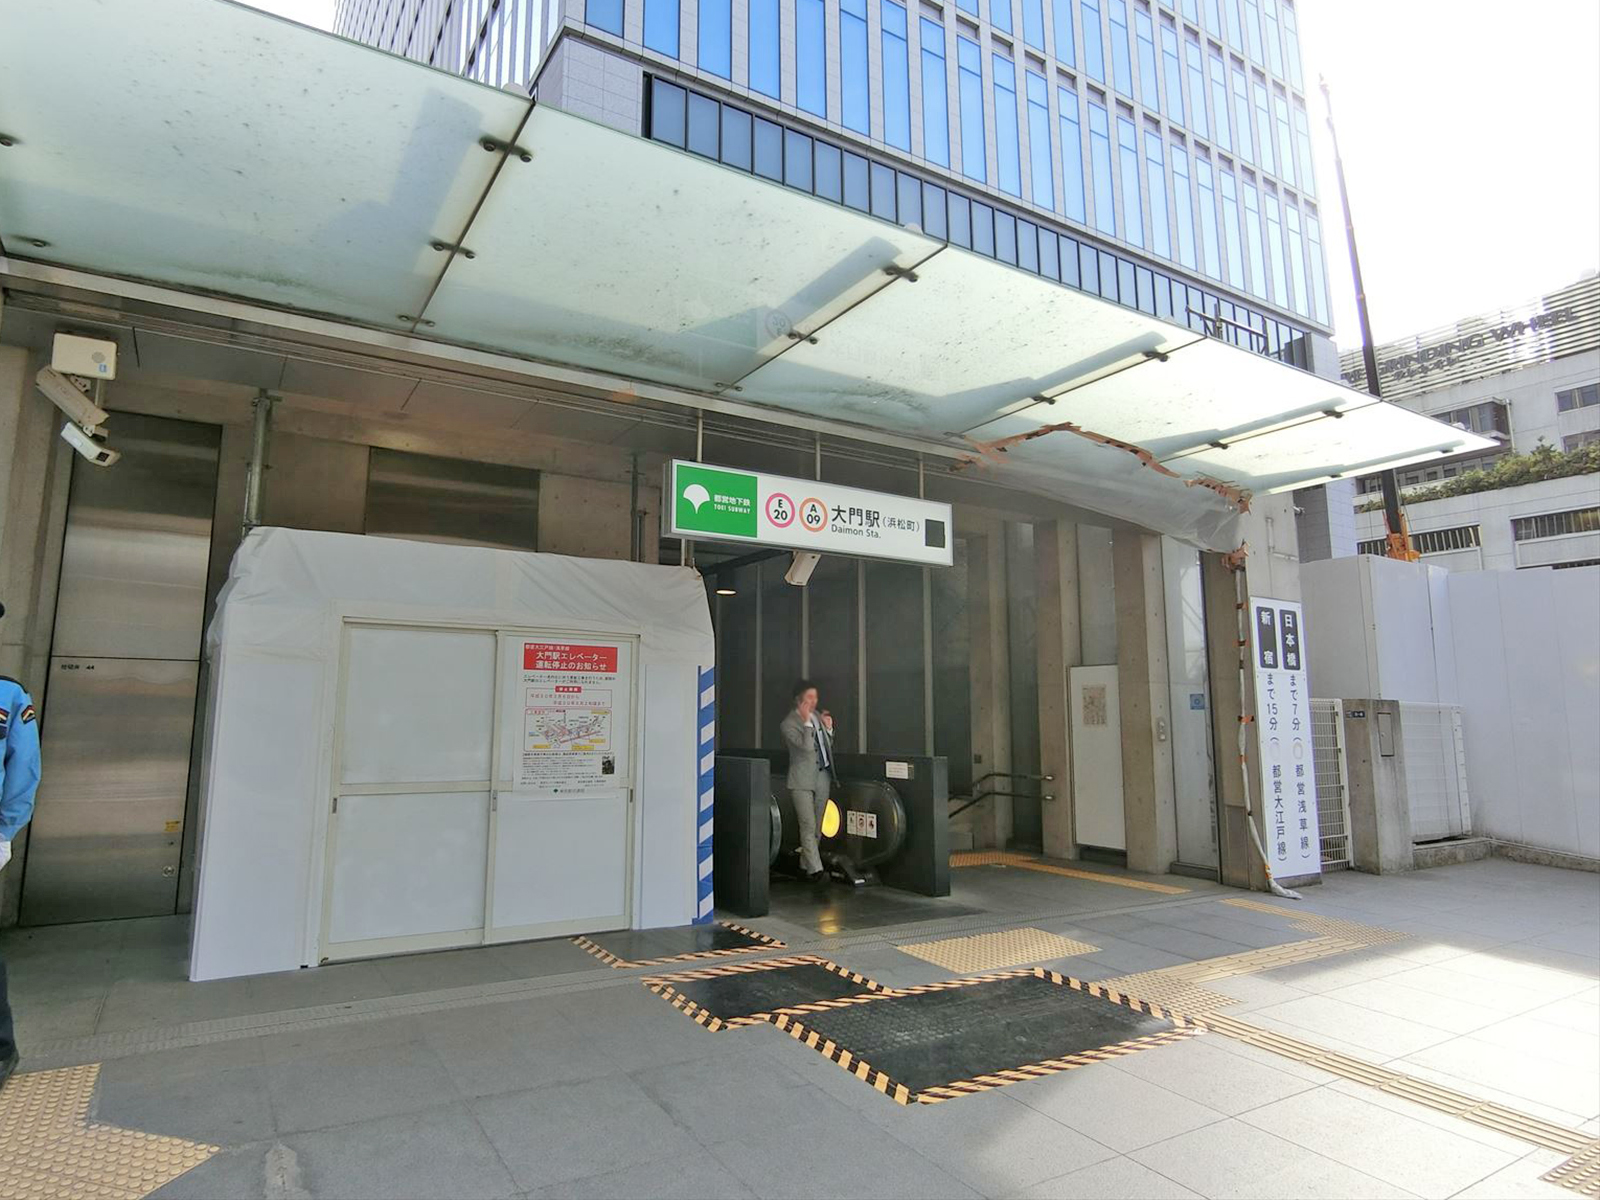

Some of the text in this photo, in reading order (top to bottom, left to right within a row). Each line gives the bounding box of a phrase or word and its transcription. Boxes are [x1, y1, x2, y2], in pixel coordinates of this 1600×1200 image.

[1377, 334, 1485, 375] GRINDING
[1490, 306, 1580, 342] WHEEL
[713, 494, 751, 507] 都営地下鉄
[777, 498, 783, 509] E
[714, 503, 751, 514] TOEI SUBWAY
[810, 503, 818, 513] A
[773, 509, 788, 521] 20
[806, 513, 821, 525] 09
[831, 504, 920, 533] 大門駅 （浜松町）
[831, 524, 881, 539] Daimon Sta.
[1260, 610, 1274, 666] 新宿
[1284, 613, 1297, 667] 日本橋
[535, 650, 608, 662] 大門駅エレベーター
[535, 660, 607, 671] 運転停止のお知らせ
